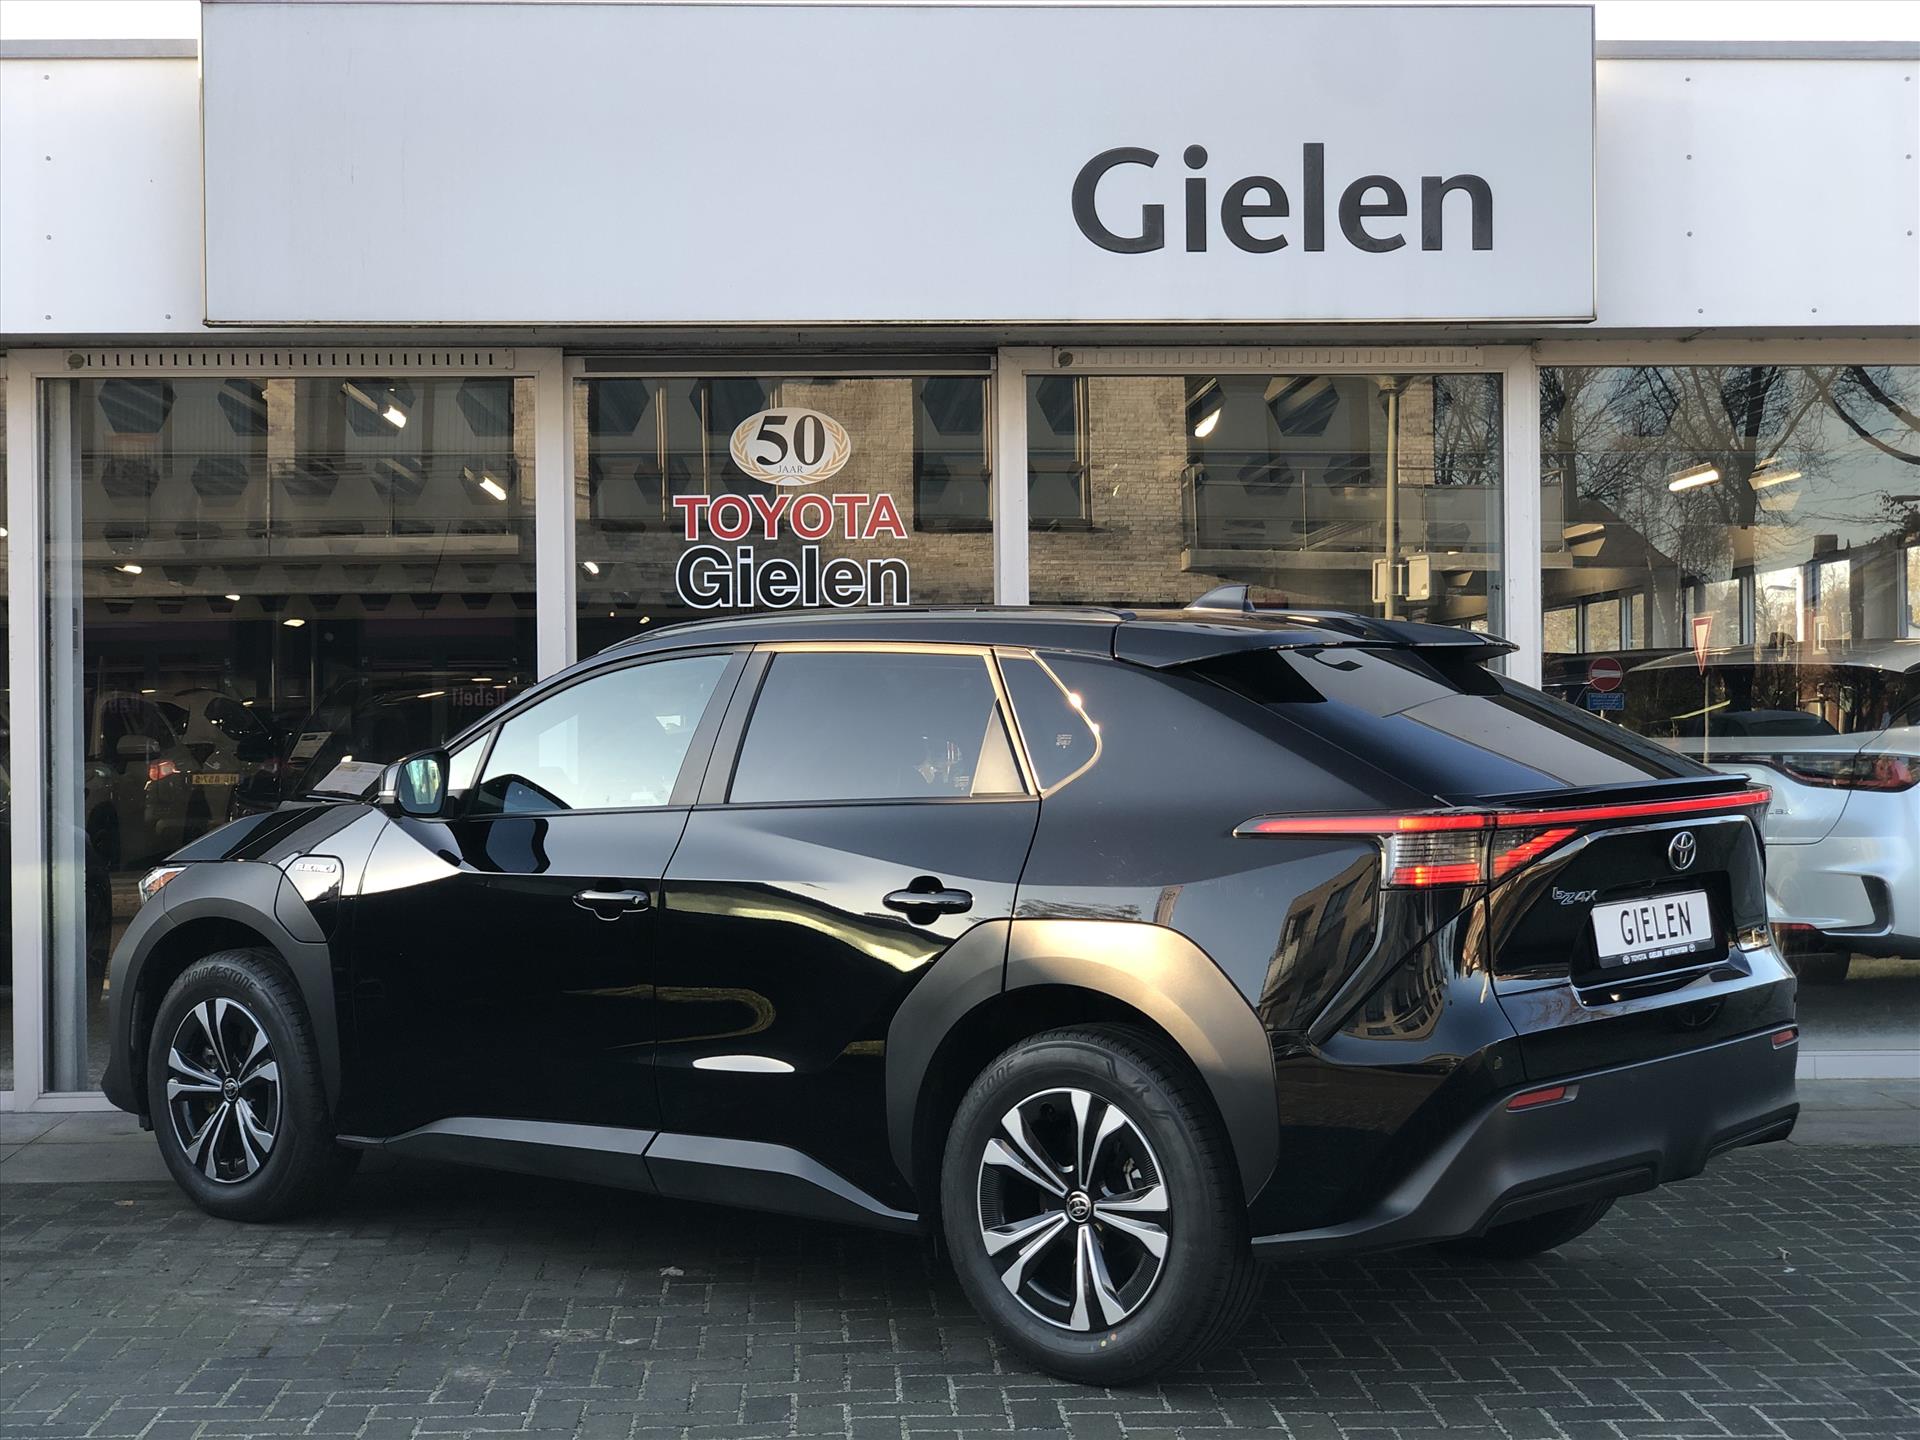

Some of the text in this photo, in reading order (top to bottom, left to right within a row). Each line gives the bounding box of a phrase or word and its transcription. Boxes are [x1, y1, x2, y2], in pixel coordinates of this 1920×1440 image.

[1072, 143, 1493, 254] Gielen
[756, 415, 825, 465] 50
[777, 465, 805, 474] JAAR
[674, 494, 908, 541] TOYOTA
[676, 545, 910, 609] Gielen
[1620, 901, 1692, 945] GIELEN
